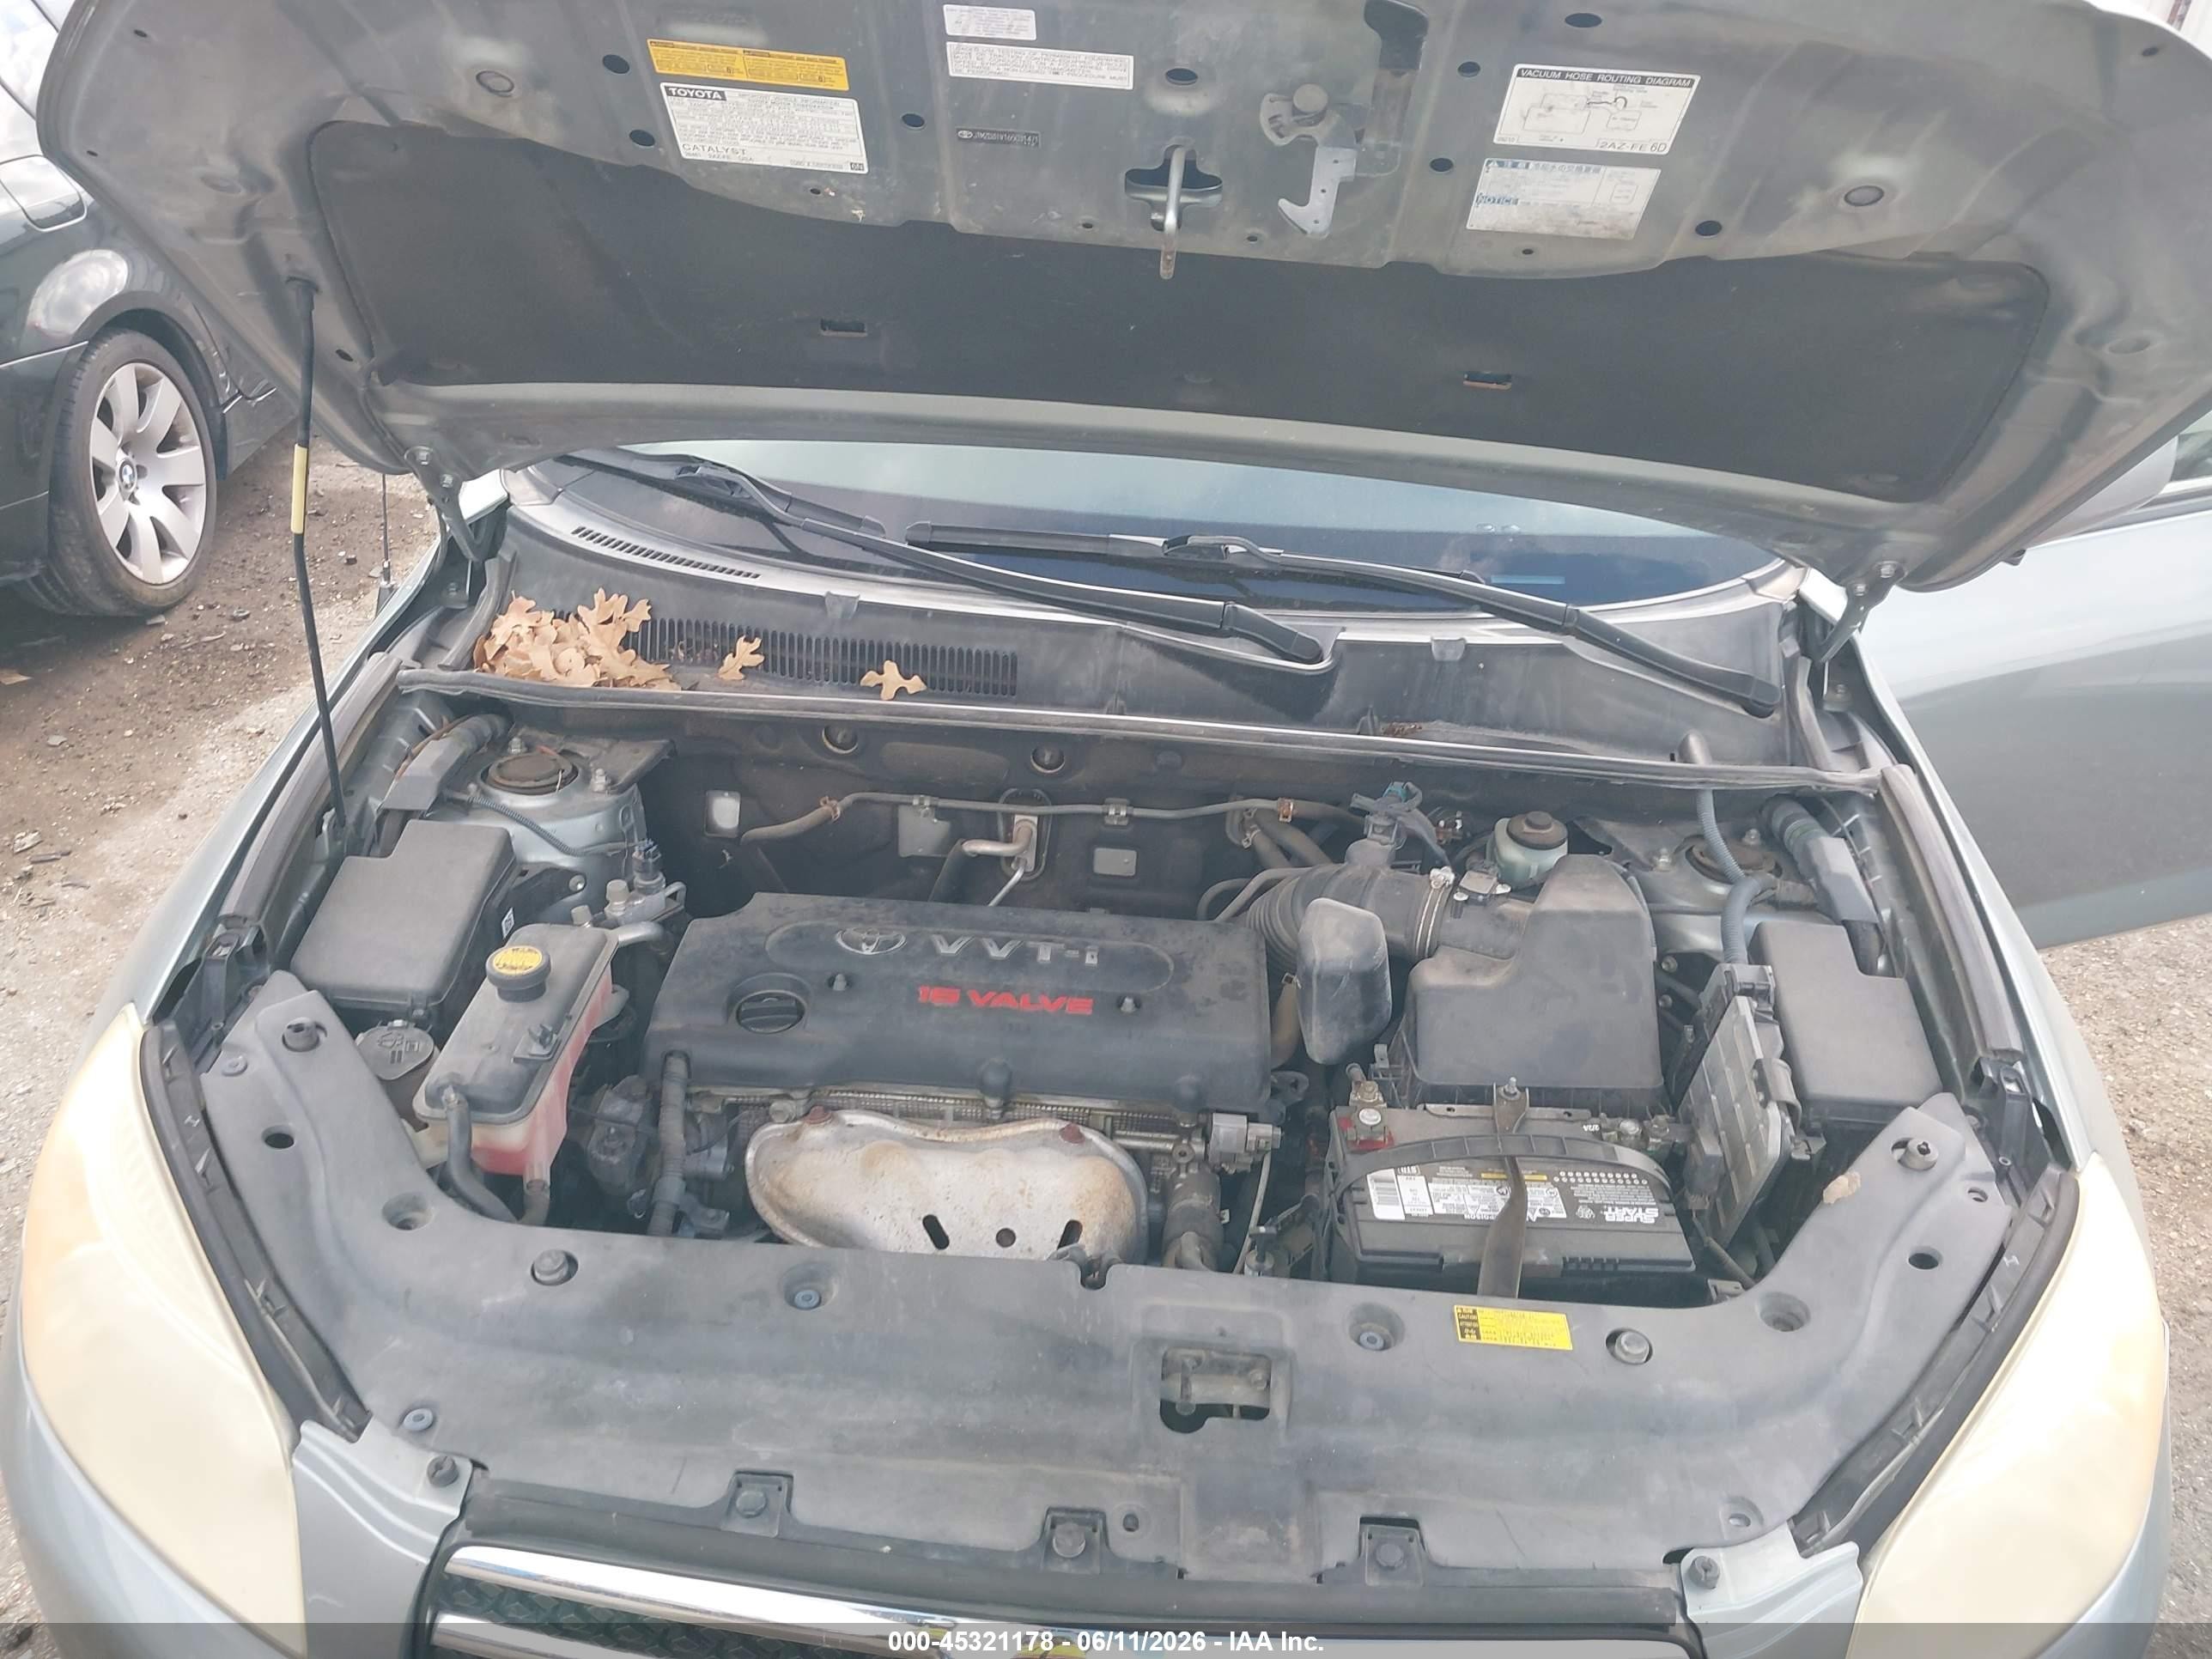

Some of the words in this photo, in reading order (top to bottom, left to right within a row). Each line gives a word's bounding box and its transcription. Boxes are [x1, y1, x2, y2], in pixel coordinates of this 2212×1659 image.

[1521, 69, 1561, 79] VACUUM
[1565, 72, 1592, 82] HOSE
[1597, 75, 1642, 84] ROUTING
[1645, 76, 1691, 88] DIAGRAM
[668, 87, 722, 100] TOYOTA
[682, 143, 747, 155] CATALYST
[919, 985, 961, 1005] 16
[967, 989, 1094, 1015] VALVE
[1604, 1212, 1656, 1224] SUPER
